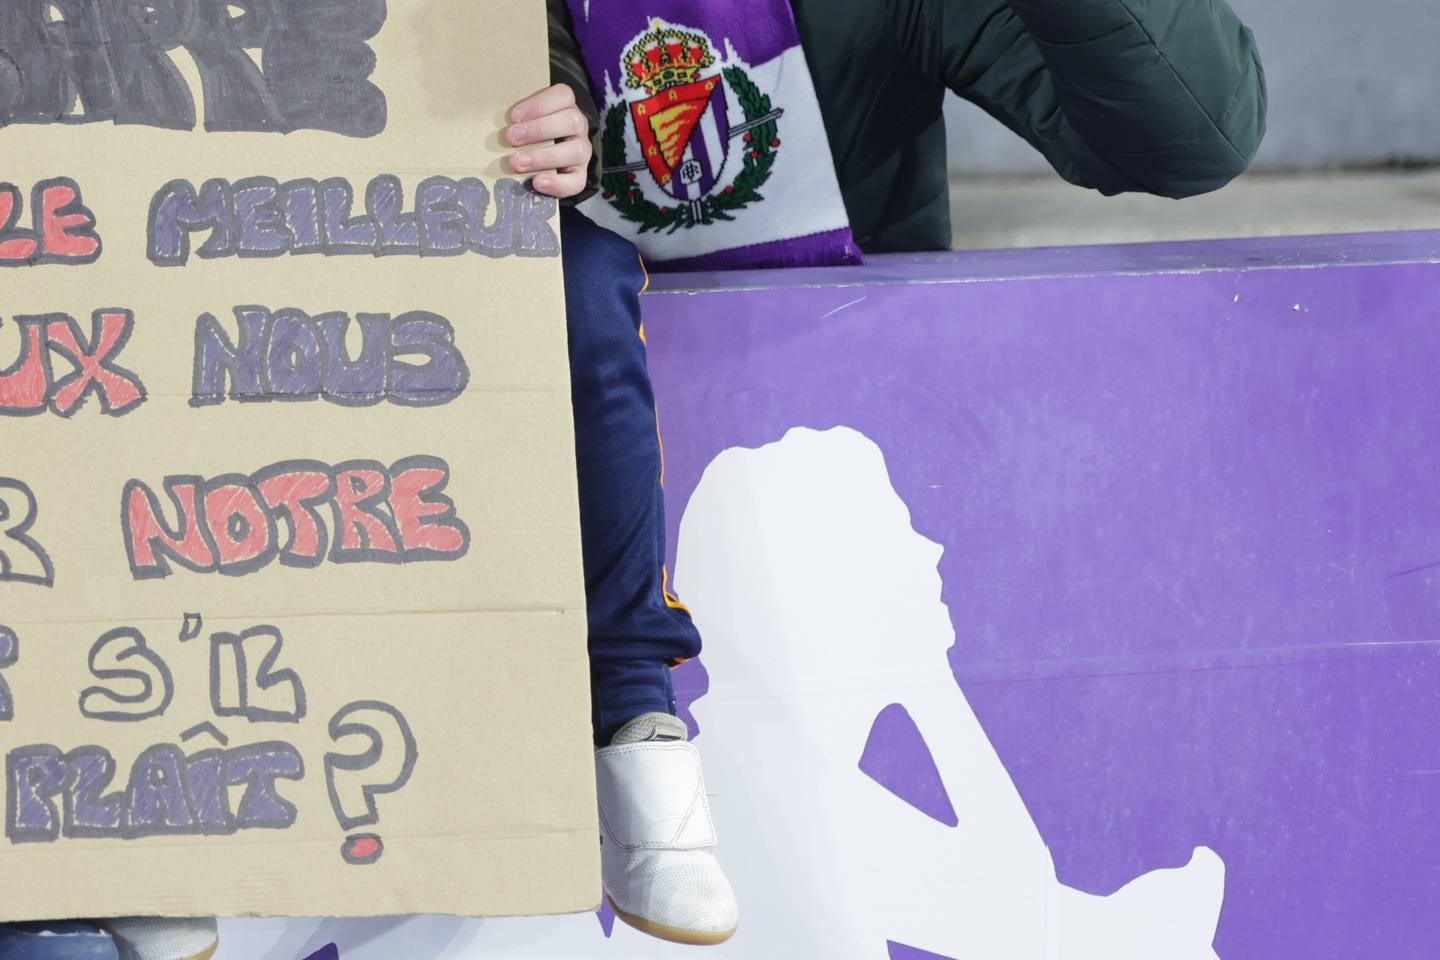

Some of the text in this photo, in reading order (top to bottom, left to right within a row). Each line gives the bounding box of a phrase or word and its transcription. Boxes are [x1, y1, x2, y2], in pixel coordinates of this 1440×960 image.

[146, 174, 561, 267] MEILLEUR
[188, 305, 471, 408] NOUS
[120, 454, 471, 580] NOTRE
[78, 612, 306, 722] S'IL
